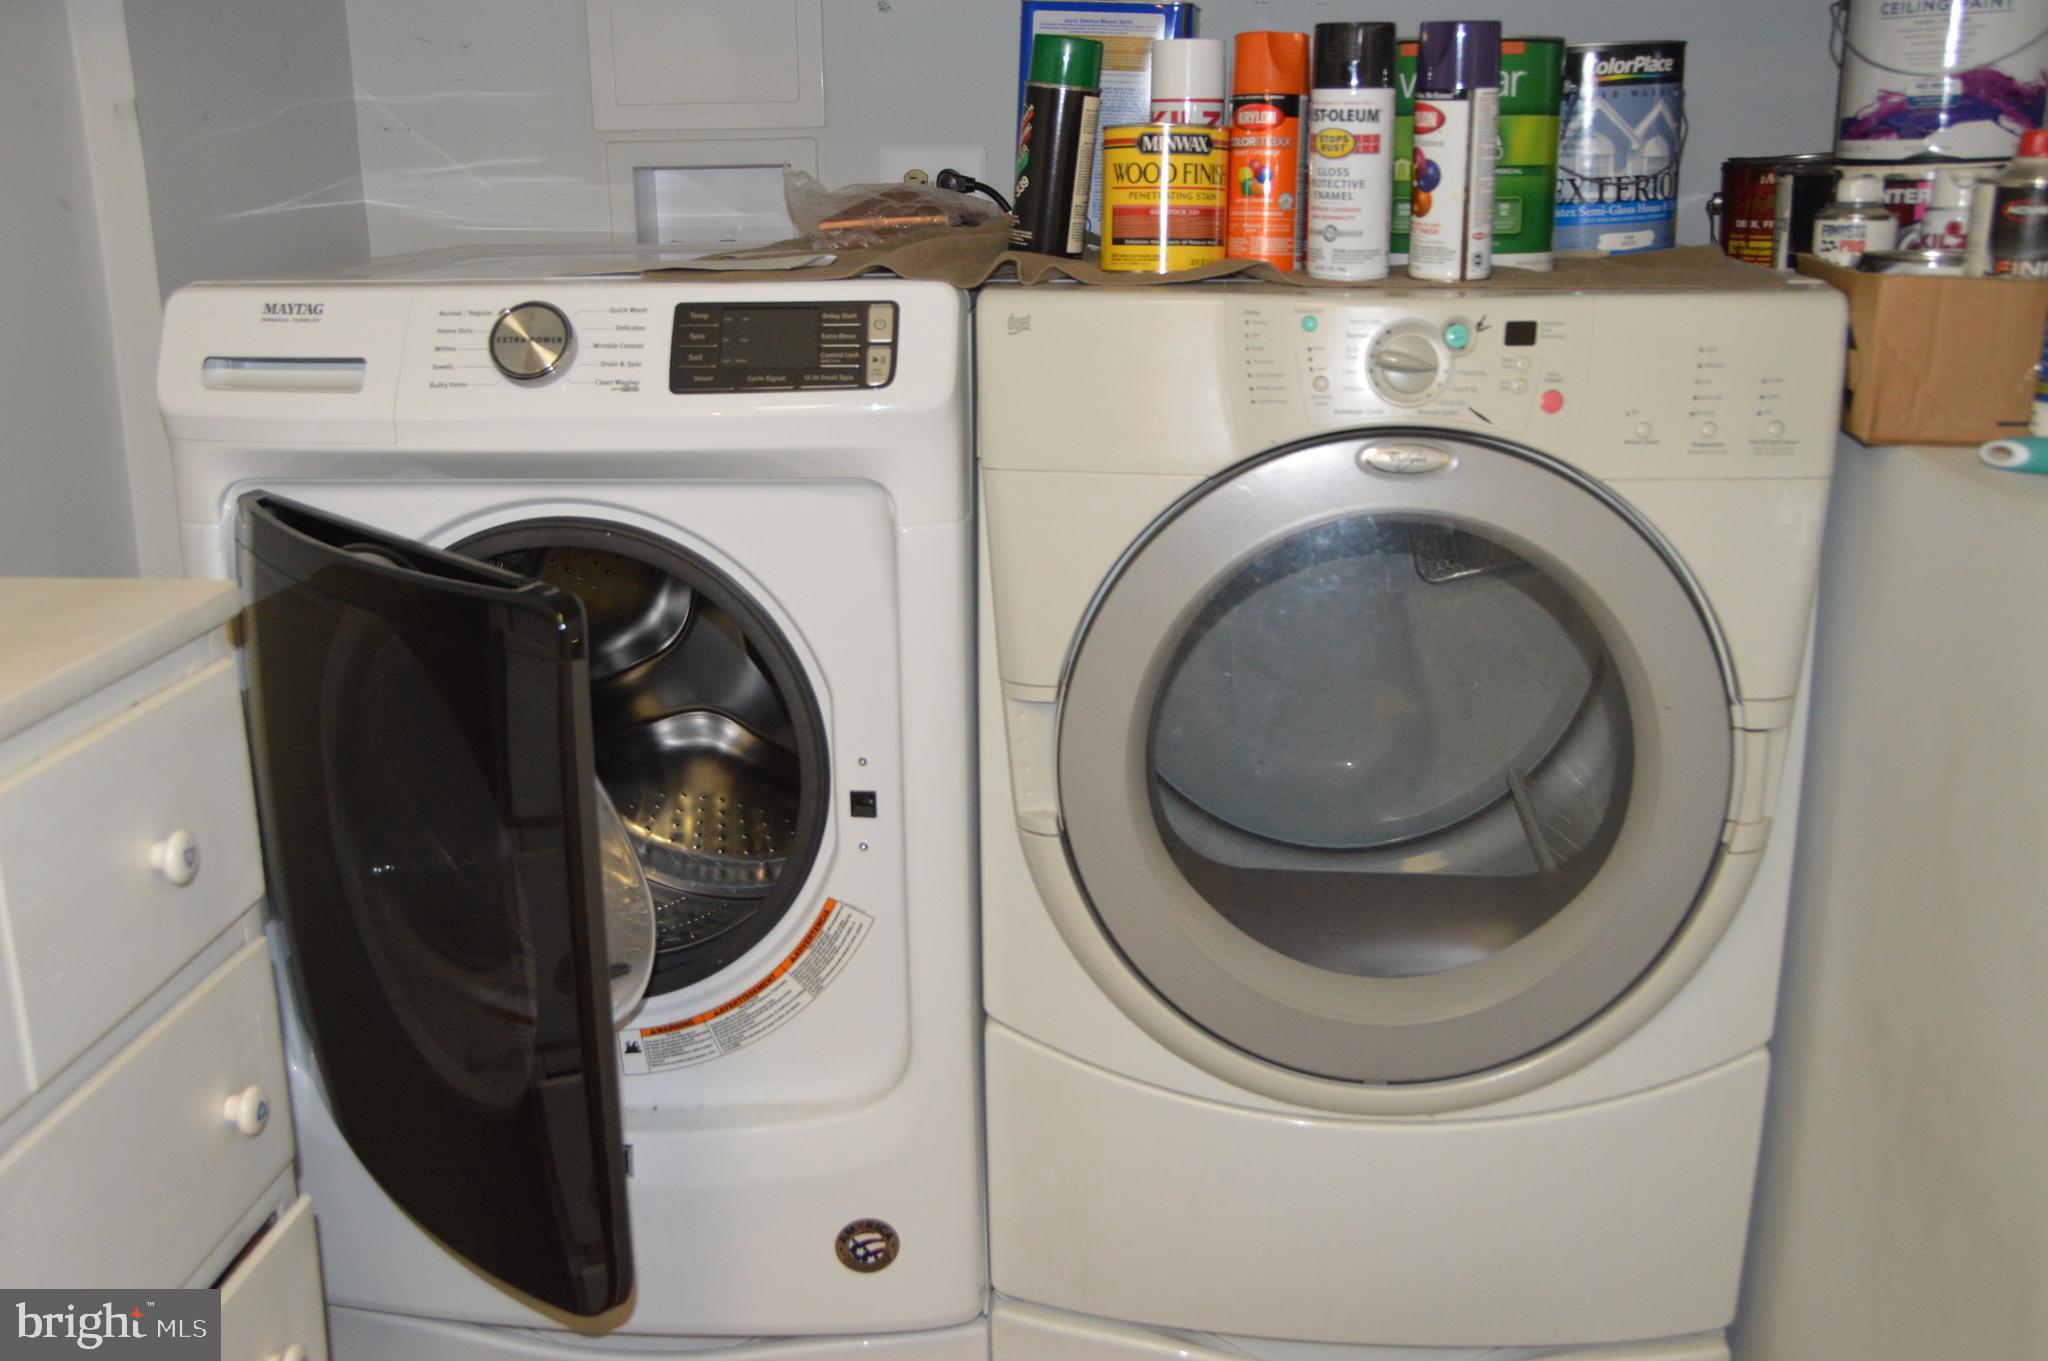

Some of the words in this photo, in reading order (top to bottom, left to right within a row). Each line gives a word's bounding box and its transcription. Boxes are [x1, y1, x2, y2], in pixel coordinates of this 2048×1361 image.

[1881, 0, 1948, 16] CEILING
[1594, 56, 1674, 75] olorPlace
[1312, 108, 1380, 122] ST-OLEUM
[1320, 135, 1347, 143] STOPS
[1321, 144, 1345, 152] RUST
[1113, 162, 1177, 184] WOOD
[1317, 168, 1350, 177] GLOSS
[1129, 191, 1193, 201] PENETATING
[1314, 191, 1354, 200] ENAMEL
[263, 302, 324, 315] MAYTAG
[609, 306, 627, 315] Quick
[629, 306, 648, 314] Wash
[439, 309, 462, 317] Normal
[468, 309, 493, 318] Regular
[690, 312, 708, 320] Temp
[822, 312, 841, 320] Delay
[457, 327, 474, 335] Duty
[615, 324, 646, 332] Delicates
[496, 336, 526, 344] EXTRA
[689, 332, 706, 341] Spin
[434, 345, 457, 353] Whites
[593, 342, 618, 350] Wrinkle
[619, 342, 644, 350] Control
[820, 351, 843, 359] Control
[844, 351, 859, 359] Lock
[432, 363, 454, 371] Towels
[600, 360, 618, 368] Drain
[626, 360, 642, 369] Spin
[595, 378, 614, 387] Clean
[747, 374, 766, 383] Cycle
[767, 374, 786, 383] Signal
[429, 381, 448, 390] Bulky
[657, 1019, 695, 1036] WARNING
